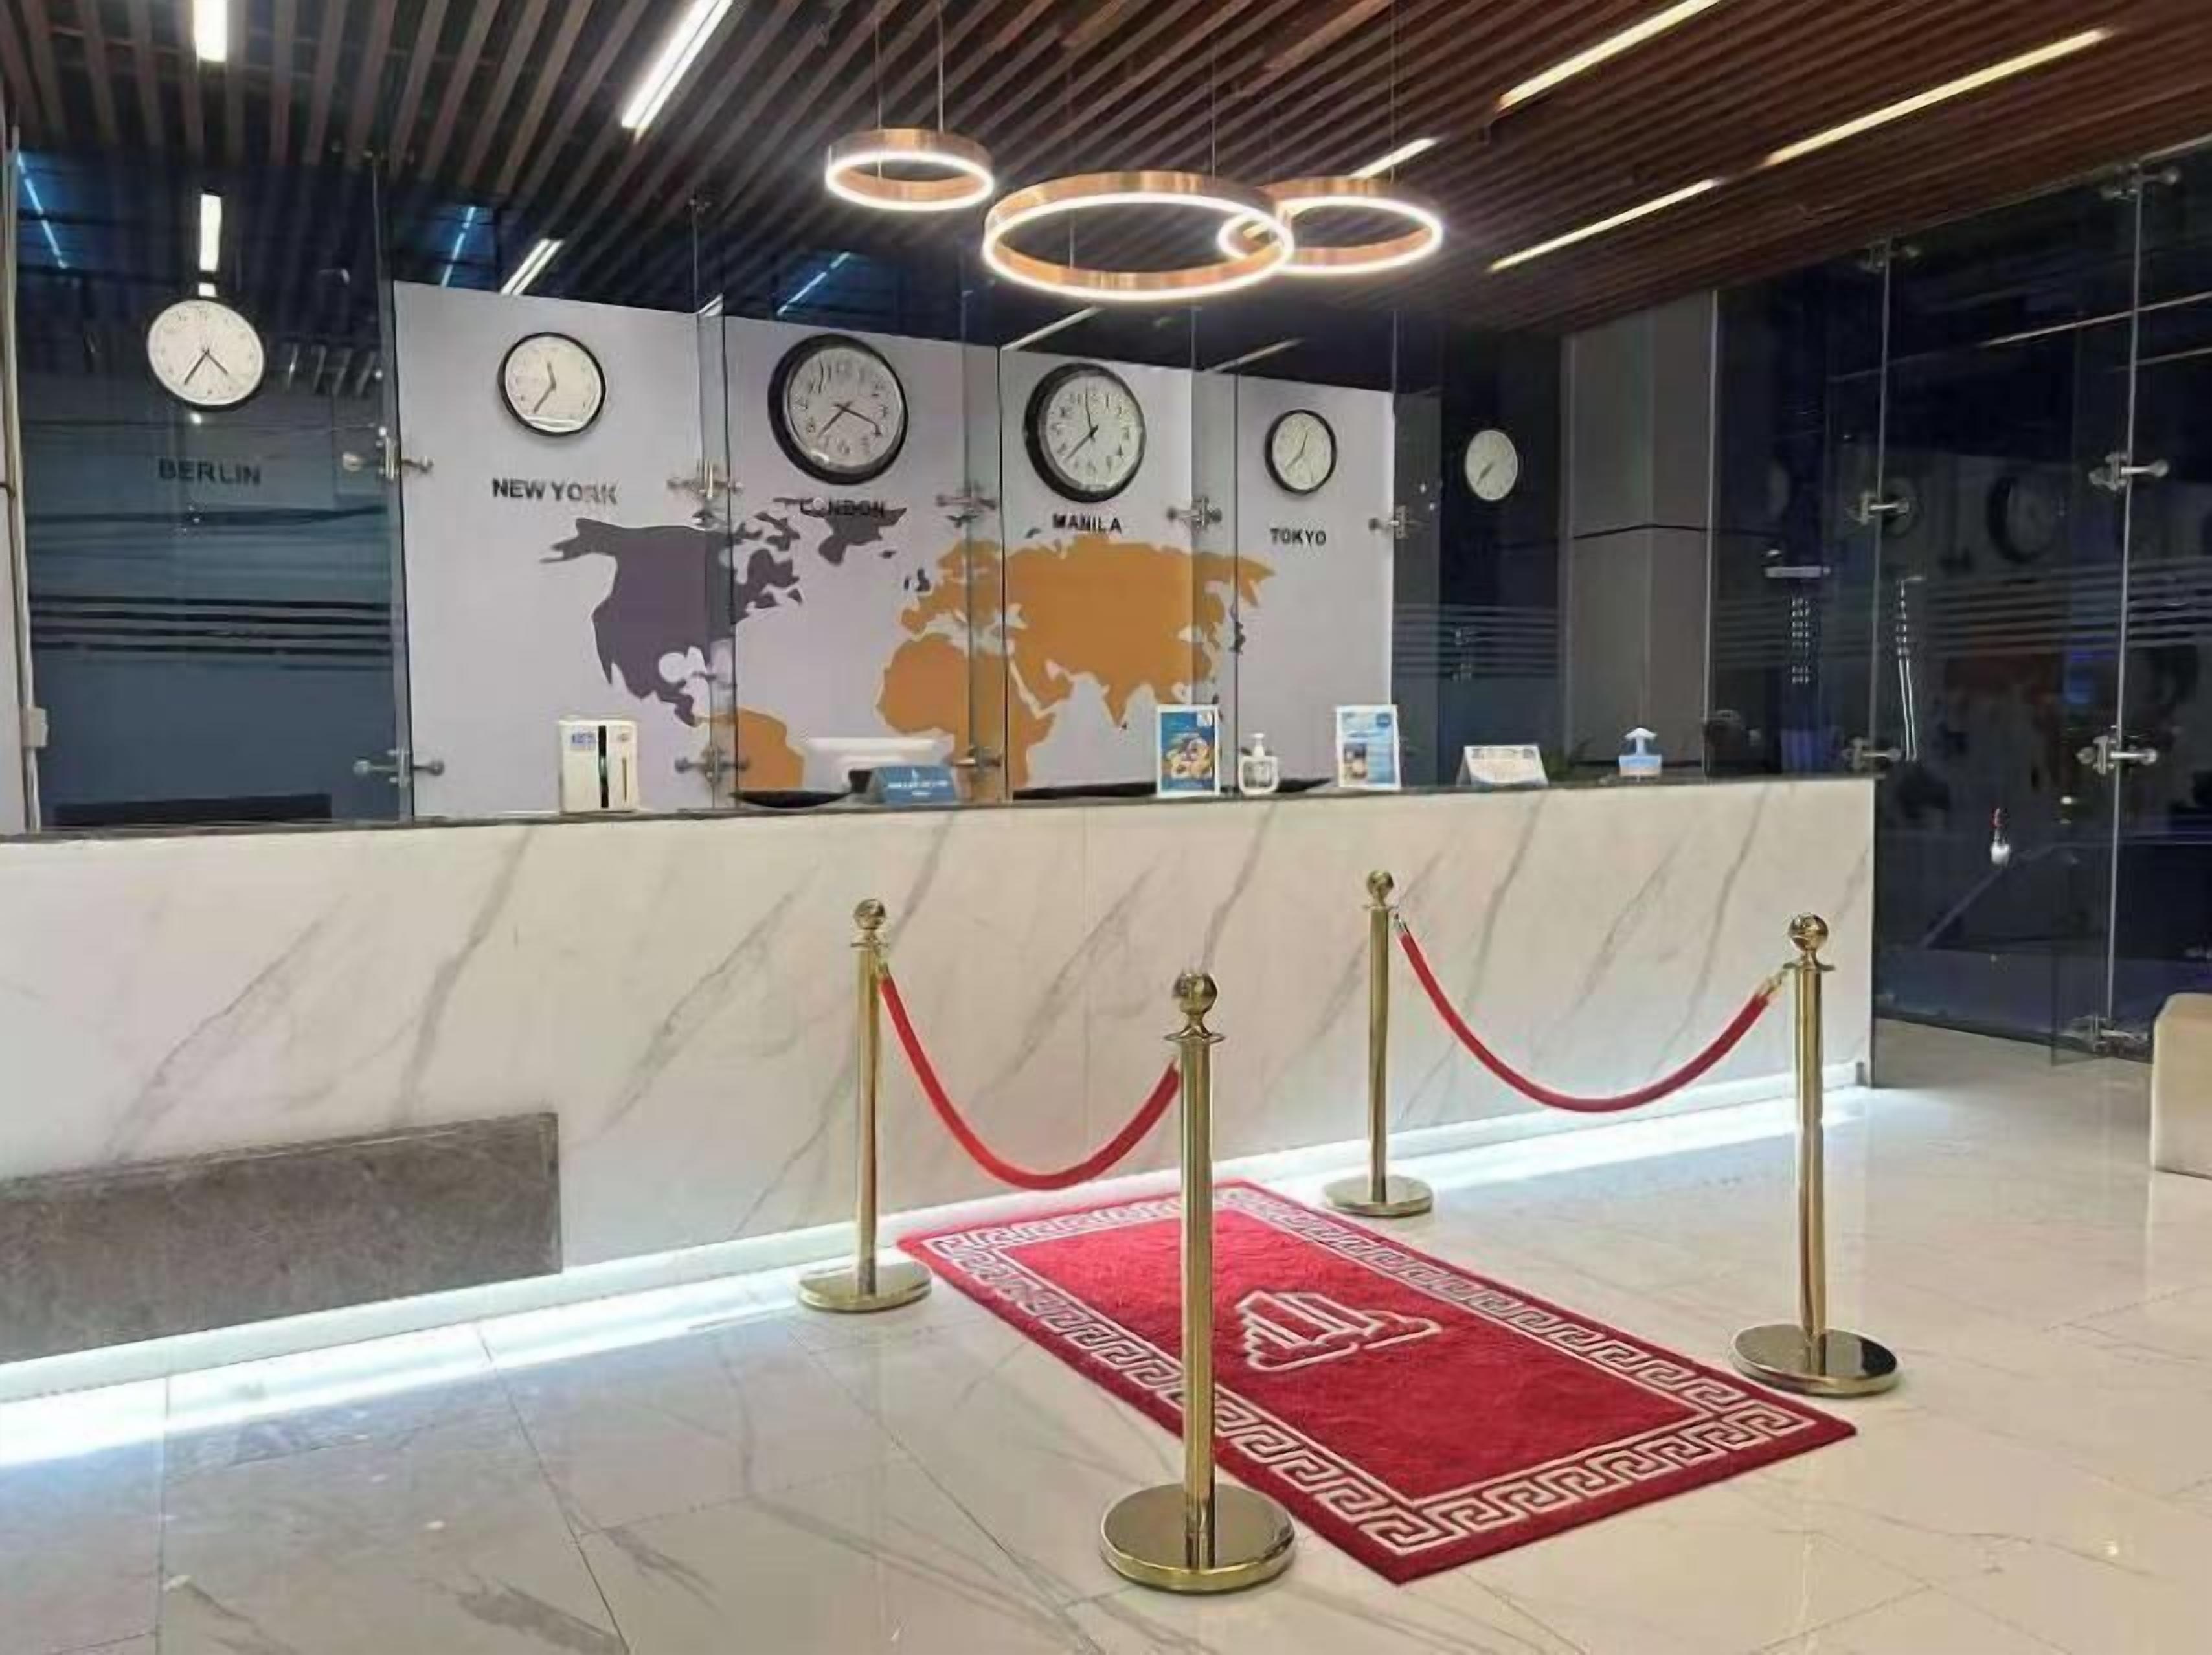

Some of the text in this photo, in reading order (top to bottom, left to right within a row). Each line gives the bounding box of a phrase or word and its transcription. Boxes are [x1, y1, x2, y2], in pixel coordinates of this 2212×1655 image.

[492, 478, 618, 505] NEW YORK
[1052, 513, 1122, 534] MANILA
[1270, 528, 1326, 546] TOKYO
